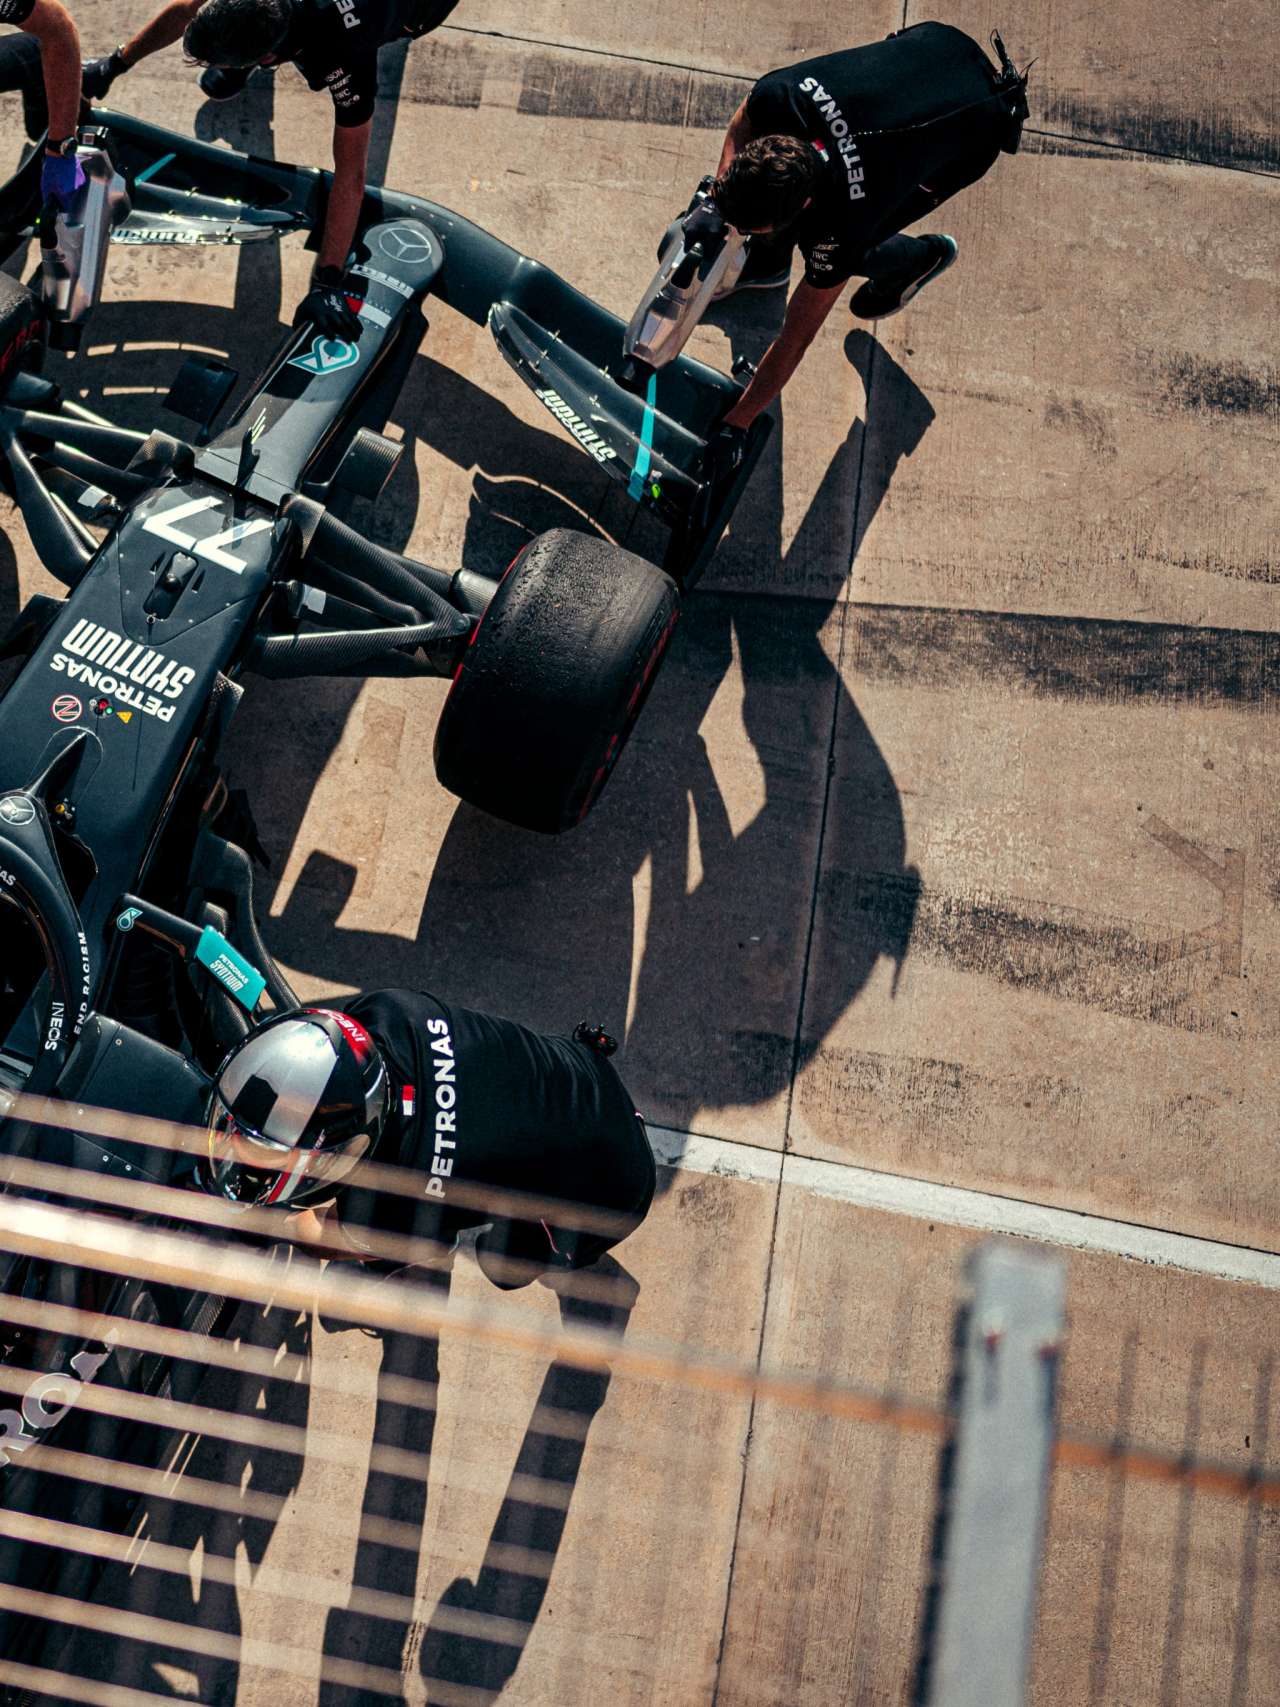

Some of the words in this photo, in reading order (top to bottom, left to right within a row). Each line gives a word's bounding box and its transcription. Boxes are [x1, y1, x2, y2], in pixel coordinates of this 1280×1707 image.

[333, 0, 361, 29] PE
[799, 77, 866, 200] PETRONAS
[142, 496, 275, 575] 77
[49, 652, 177, 723] PETRONAS
[61, 618, 196, 699] SYNTIUM
[78, 931, 91, 996] RACISM
[209, 959, 244, 992] SYNTIUM
[219, 953, 249, 985] PETRONAS
[44, 1001, 65, 1051] INEOS
[73, 1002, 88, 1036] END
[424, 1018, 457, 1199] PETRONAS
